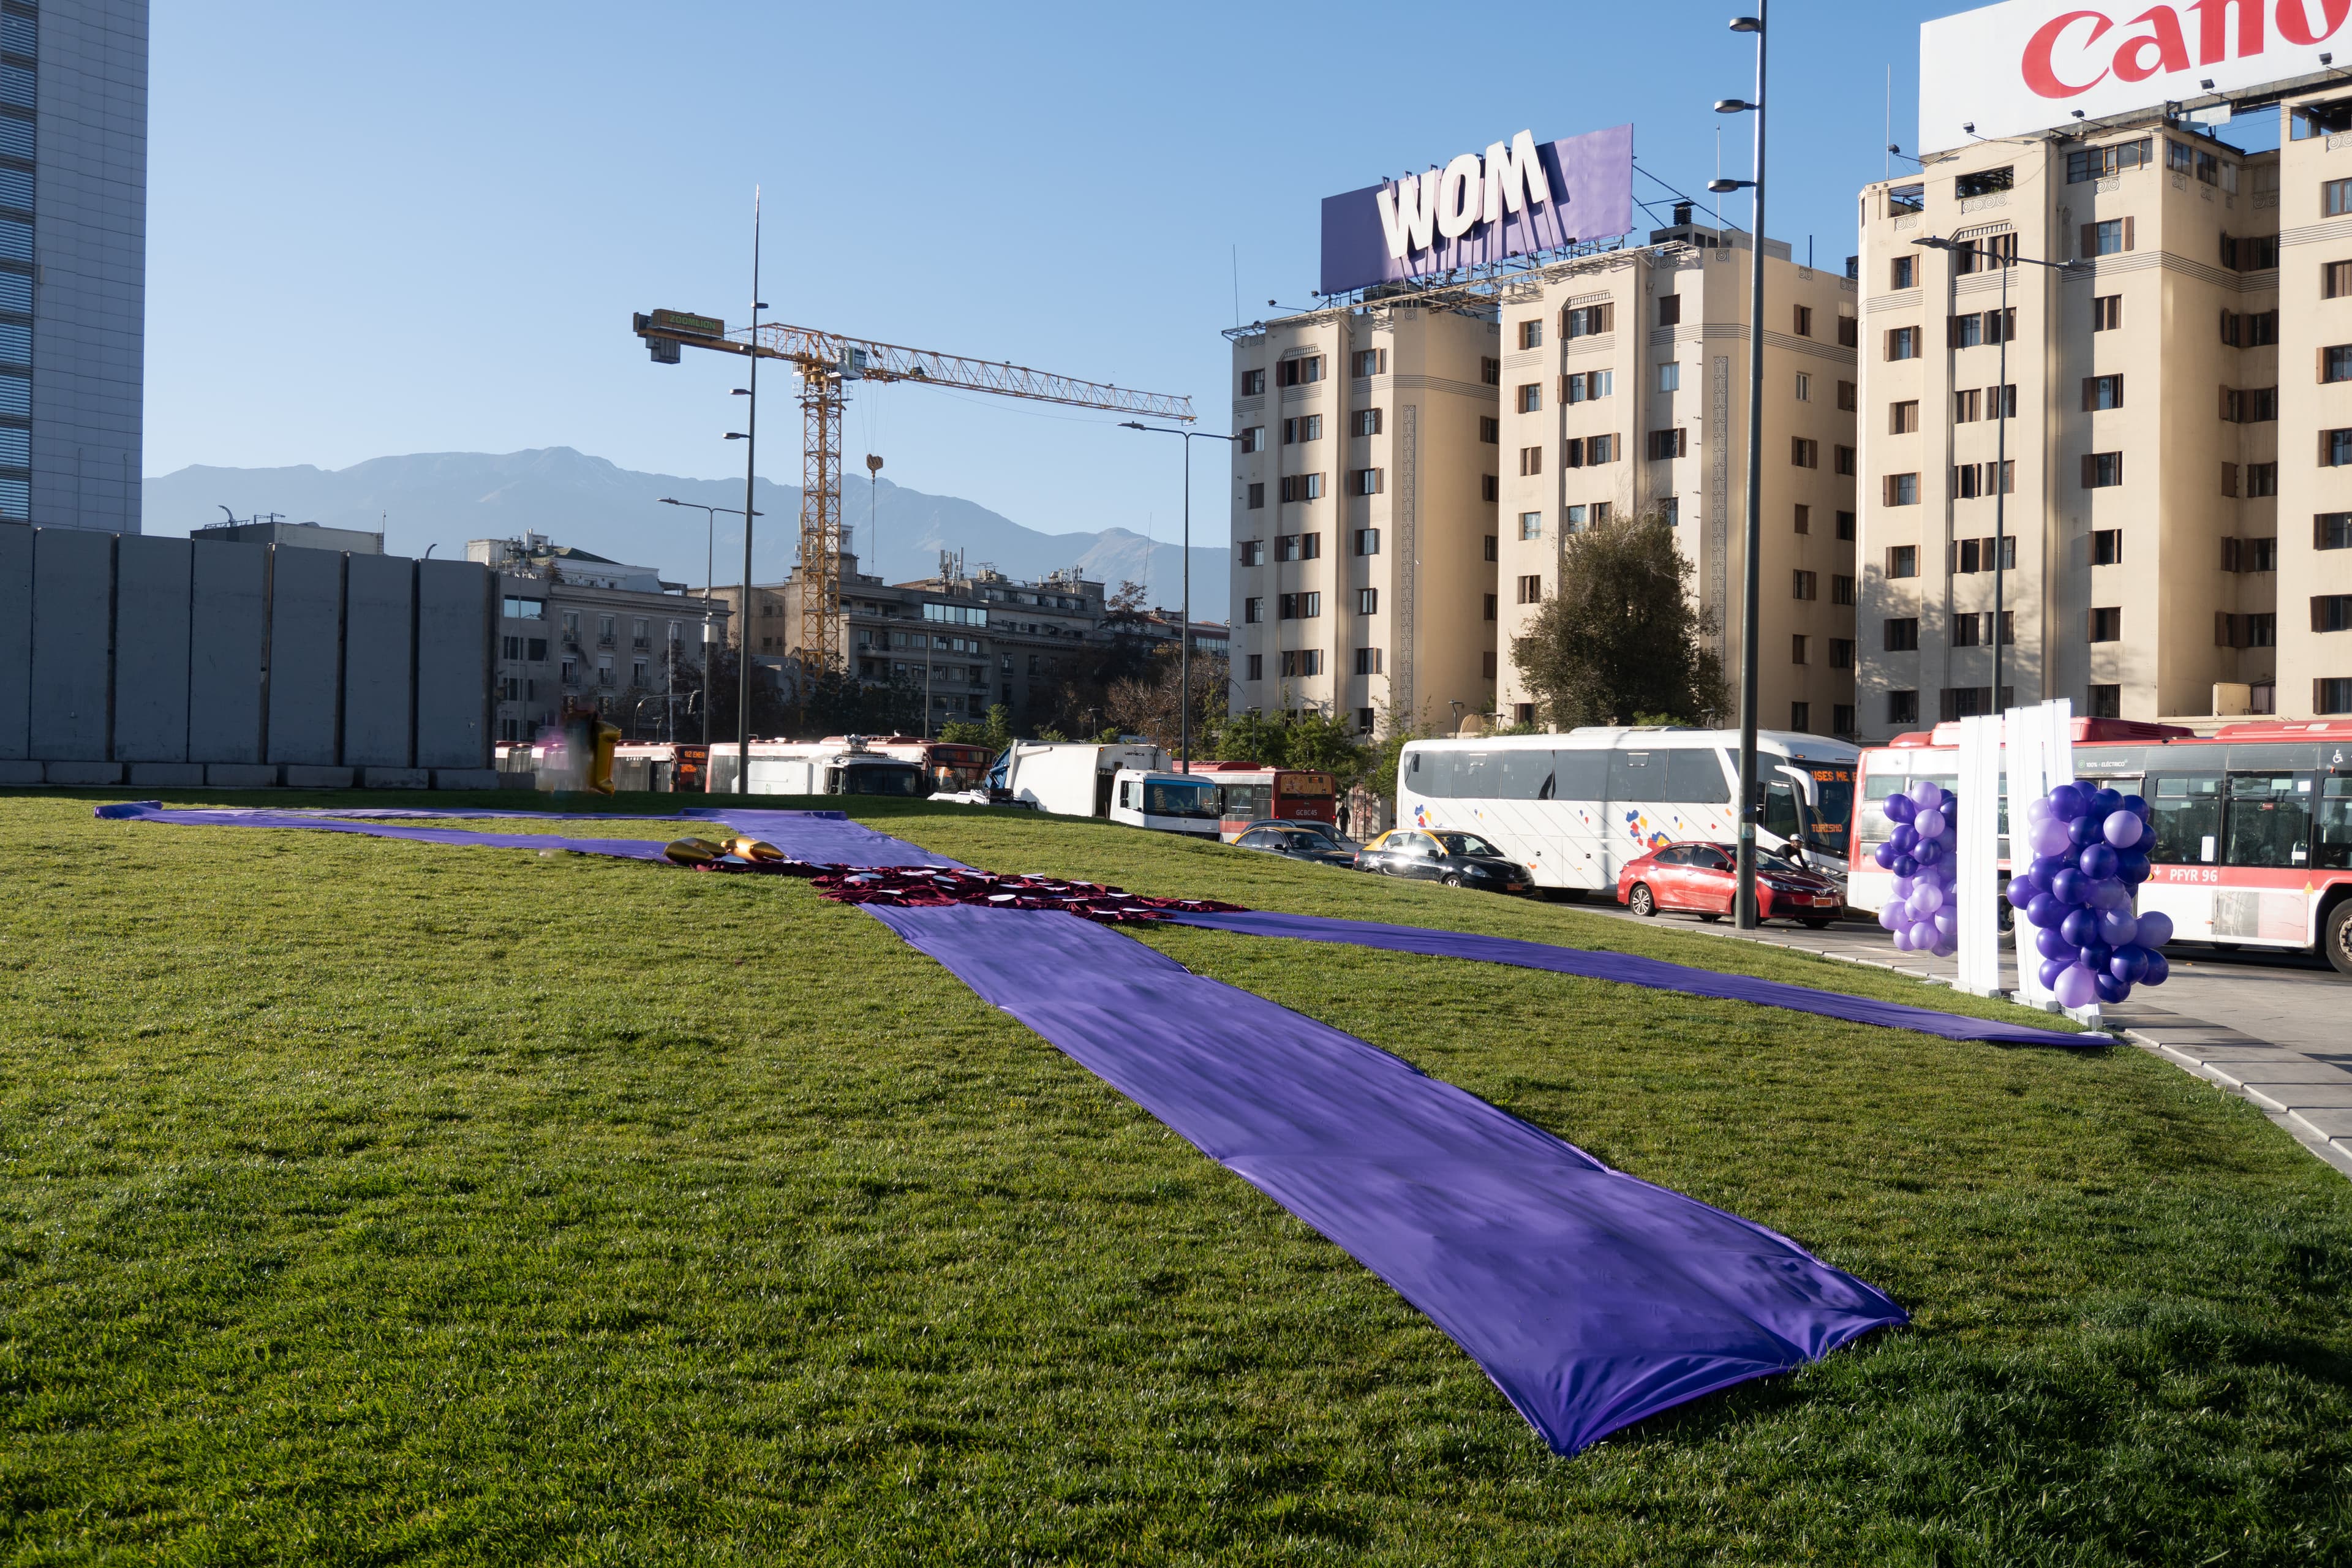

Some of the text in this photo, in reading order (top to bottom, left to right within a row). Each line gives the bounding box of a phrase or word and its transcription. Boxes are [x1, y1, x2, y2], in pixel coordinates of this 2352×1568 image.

[1376, 129, 1548, 259] WOM
[669, 314, 716, 330] ZOOMLION
[1811, 823, 1843, 833] TURISMO
[2169, 868, 2218, 883] PFYR 96
